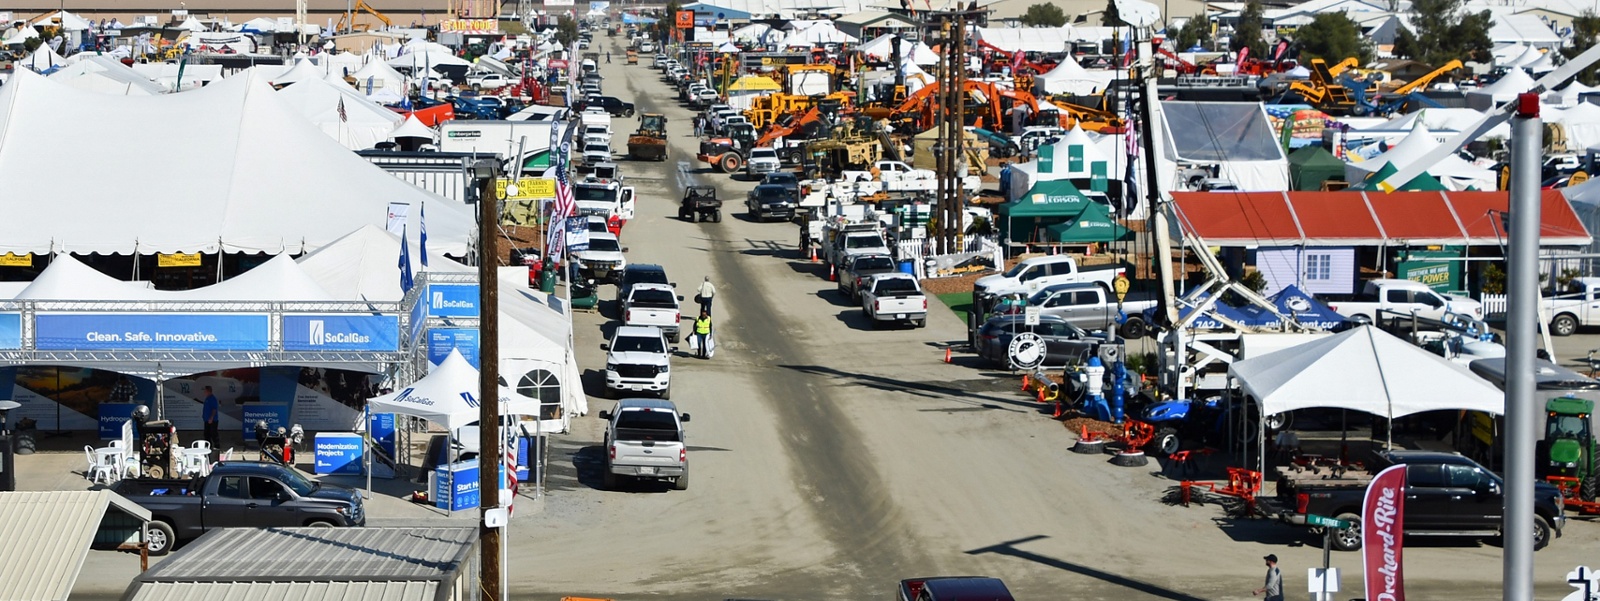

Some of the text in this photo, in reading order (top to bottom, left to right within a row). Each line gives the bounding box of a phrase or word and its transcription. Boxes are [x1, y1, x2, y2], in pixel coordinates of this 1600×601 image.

[448, 21, 490, 30] FAIR FOOD
[1423, 272, 1449, 283] POWER
[443, 300, 474, 308] SoCalGas
[86, 331, 218, 342] Clean. Safe. Innovative.
[324, 332, 370, 343] SoCalGas
[404, 395, 435, 406] SoCalGas
[456, 482, 472, 491] Start
[1321, 518, 1340, 527] STREET
[1373, 487, 1398, 601] Orchard-Rite
